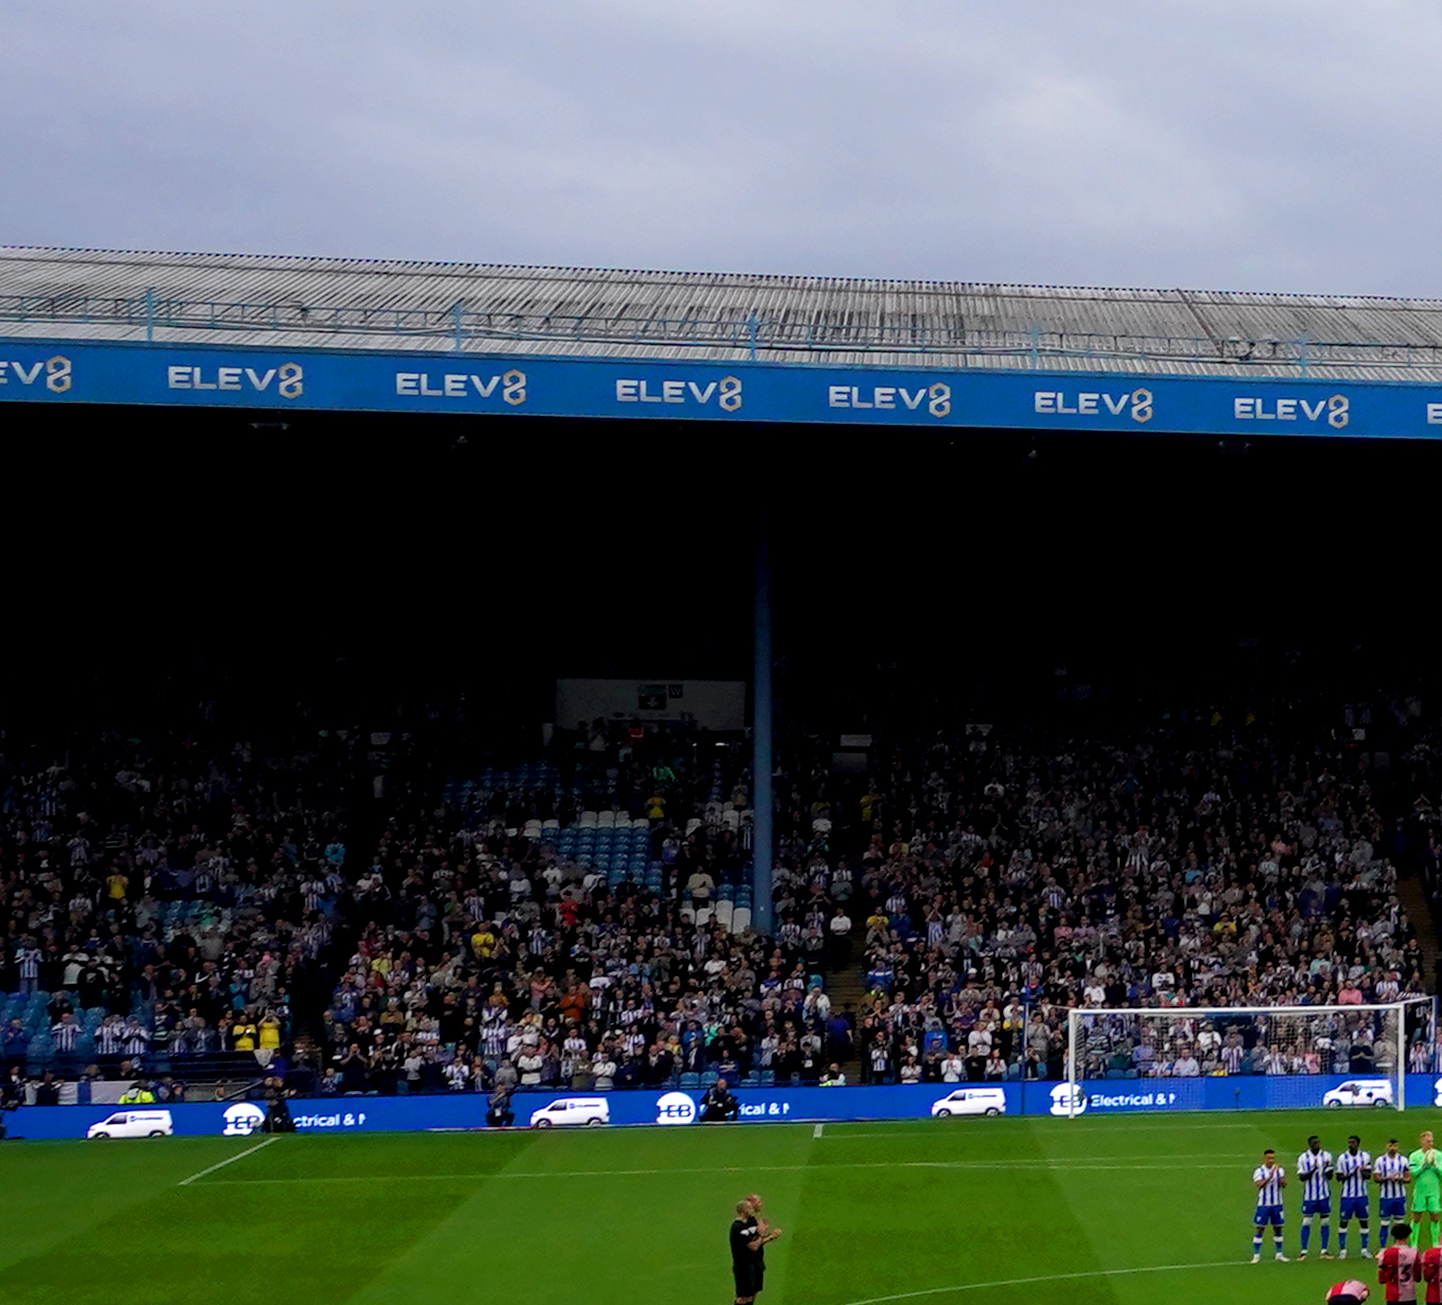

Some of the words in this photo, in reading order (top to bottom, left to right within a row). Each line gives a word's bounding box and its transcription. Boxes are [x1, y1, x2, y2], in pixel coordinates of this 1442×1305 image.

[169, 362, 303, 398] ELEV8
[397, 369, 527, 406] ELEV8
[617, 375, 742, 412] ELEV8
[830, 382, 951, 418] ELEV8
[1035, 388, 1153, 423] ELEV8
[1235, 394, 1349, 429] ELEV8
[768, 1102, 781, 1114] &
[1091, 1093, 1153, 1107] Electrical
[1155, 1092, 1166, 1106] &
[342, 1113, 356, 1126] &
